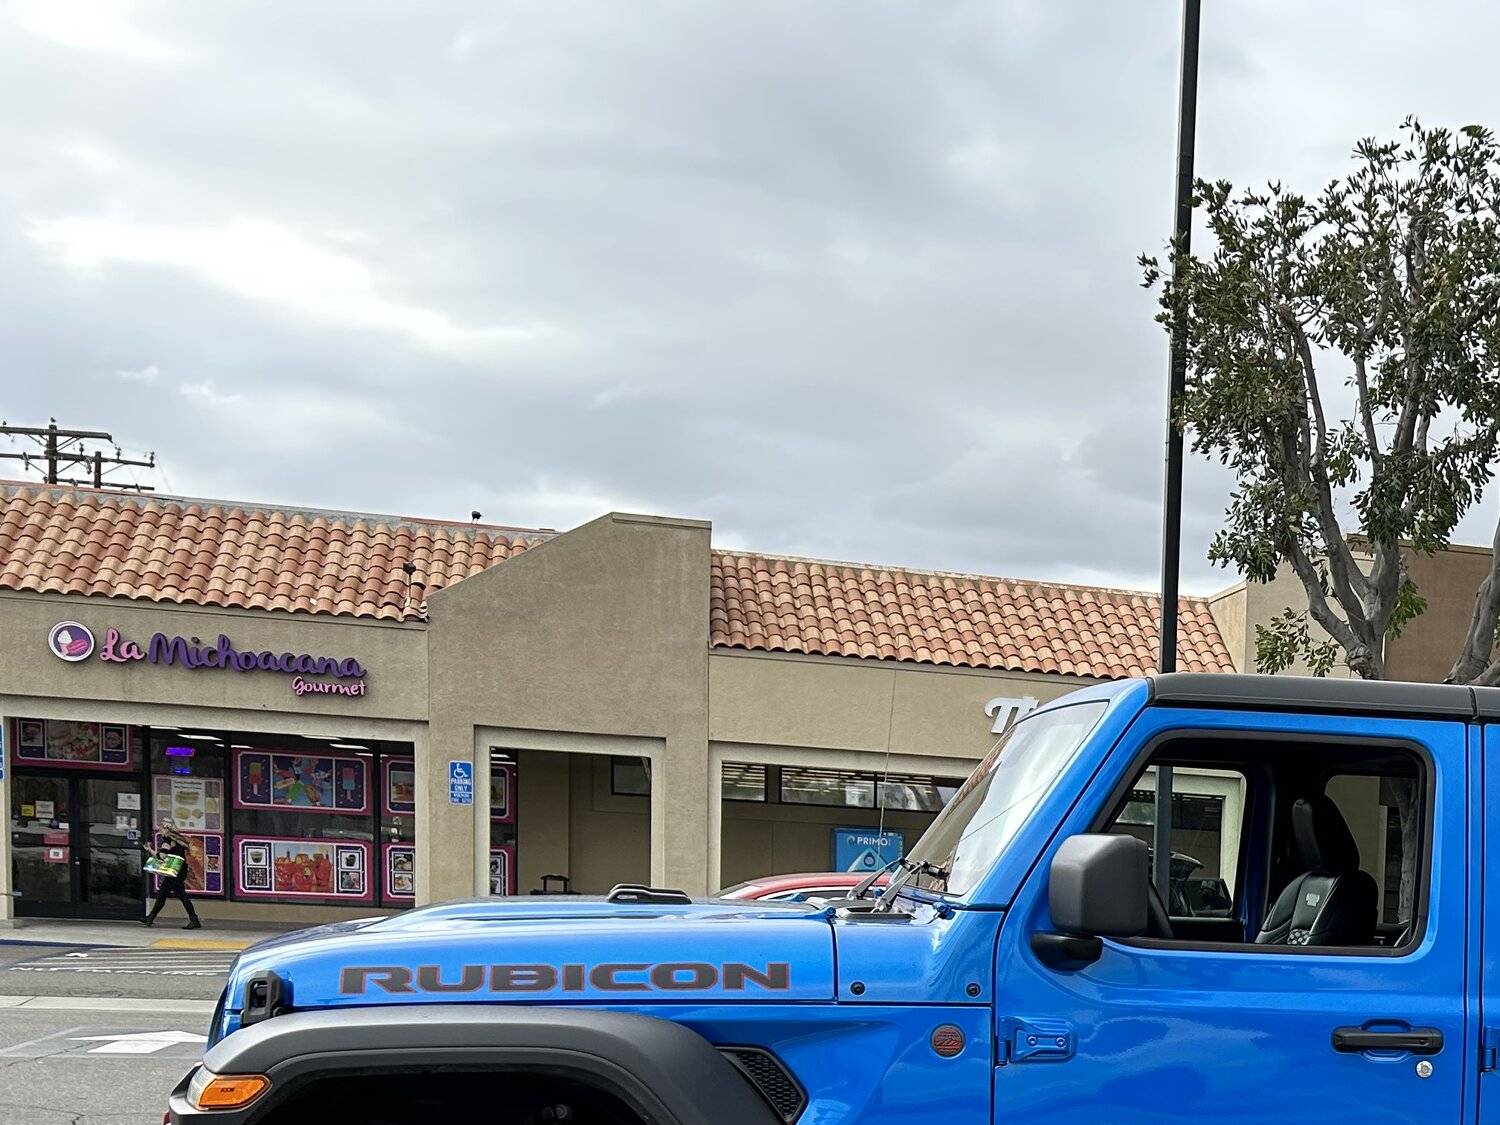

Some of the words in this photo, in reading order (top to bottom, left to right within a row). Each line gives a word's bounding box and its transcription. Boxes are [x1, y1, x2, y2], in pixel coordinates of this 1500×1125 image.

[100, 627, 147, 663] La
[149, 631, 367, 679] Michoacana
[291, 676, 366, 697] Gourmet
[857, 836, 888, 846] PRIMO
[339, 962, 790, 994] RUBICON
